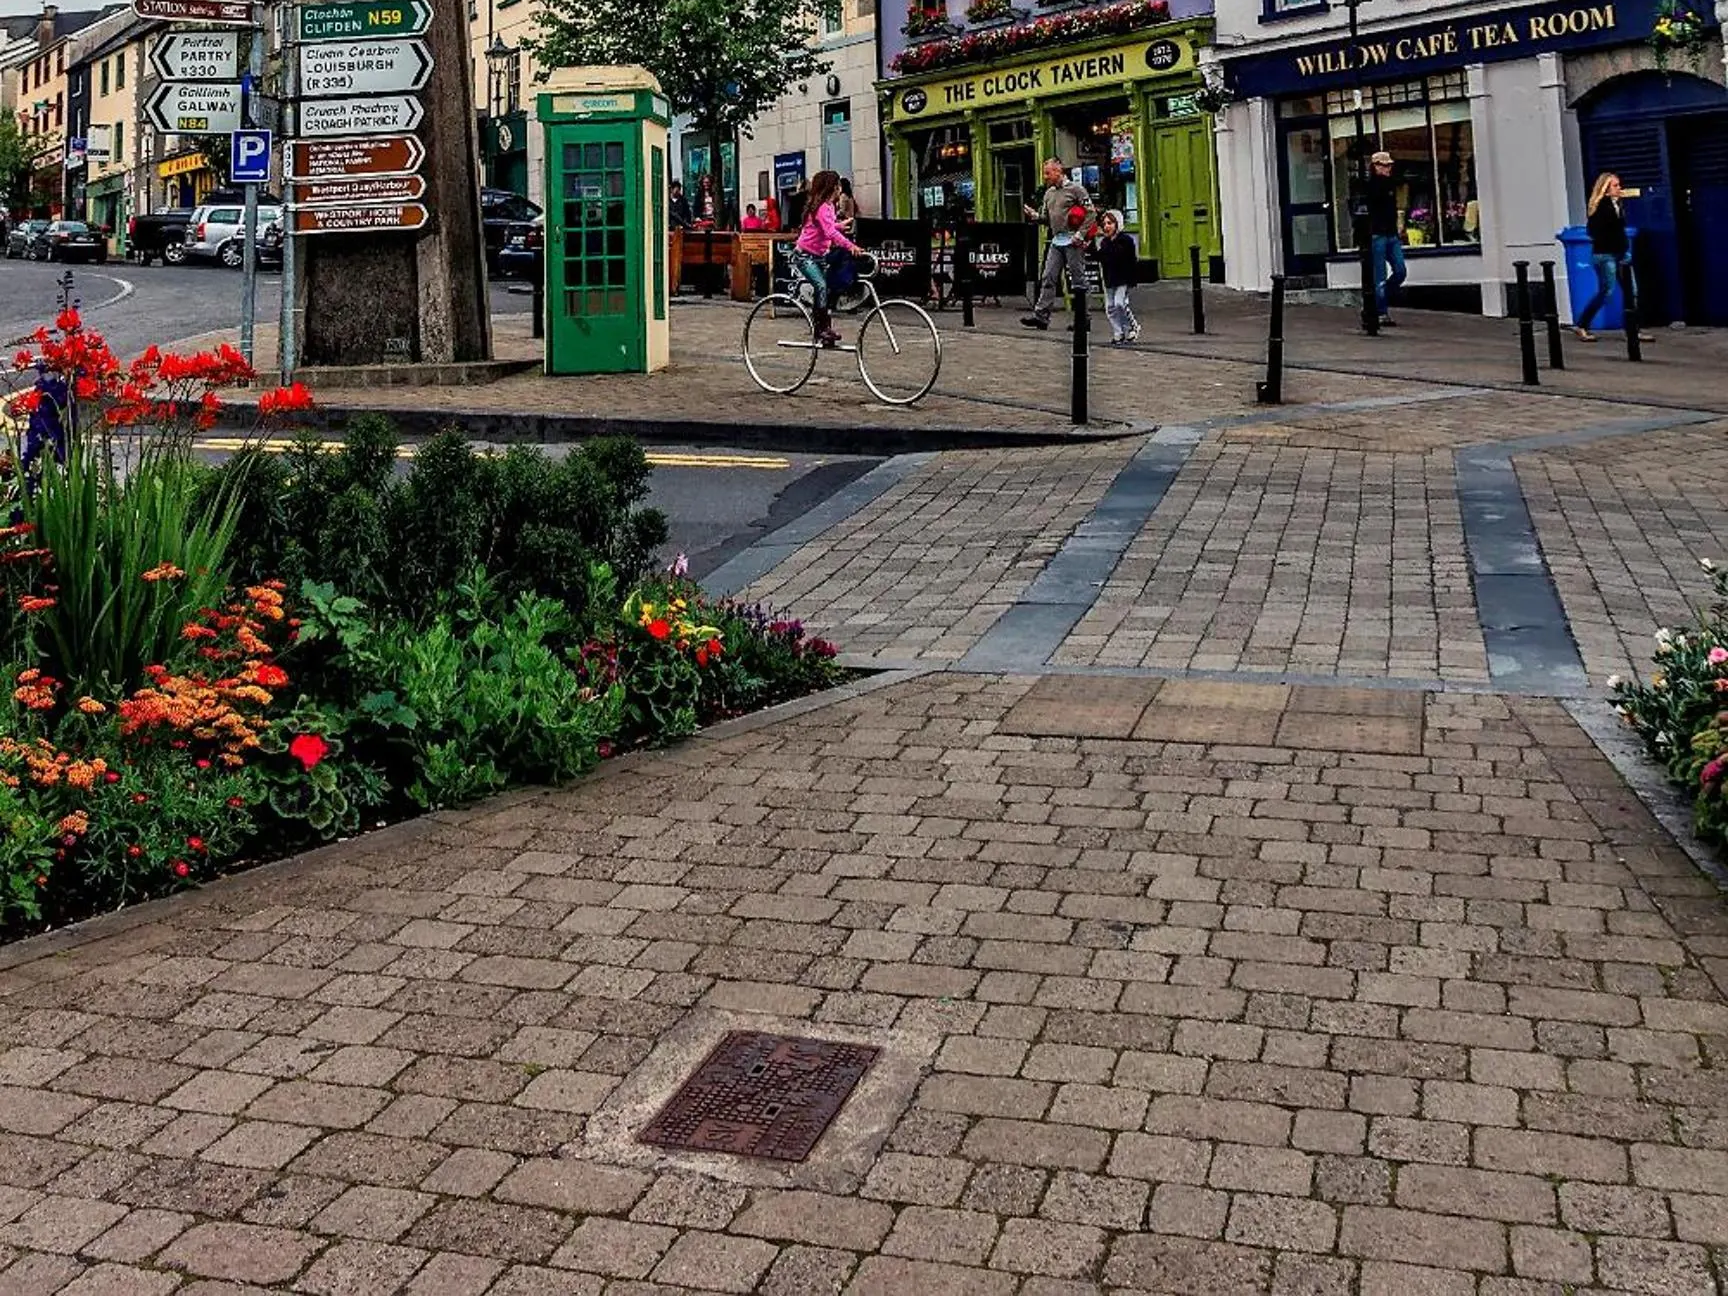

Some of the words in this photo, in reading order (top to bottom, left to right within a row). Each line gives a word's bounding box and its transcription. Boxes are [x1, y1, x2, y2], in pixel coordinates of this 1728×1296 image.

[142, 1, 187, 13] STATION
[368, 9, 402, 25] N59
[304, 21, 362, 34] CLIFDEN
[1395, 25, 1458, 60] CAFÉ
[1467, 21, 1519, 50] TEA
[1529, 4, 1616, 40] ROOM
[181, 50, 232, 62] PARTRY
[944, 81, 976, 104] THE
[983, 69, 1042, 96] CLOCK
[1051, 53, 1124, 85] TAVERN
[177, 101, 236, 113] GALWAY
[179, 118, 207, 129] N84
[305, 119, 352, 131] CROAGH
[354, 115, 399, 127] PATRICK
[239, 135, 265, 166] P
[326, 217, 372, 228] COUNTRY
[374, 216, 401, 225] PARK
